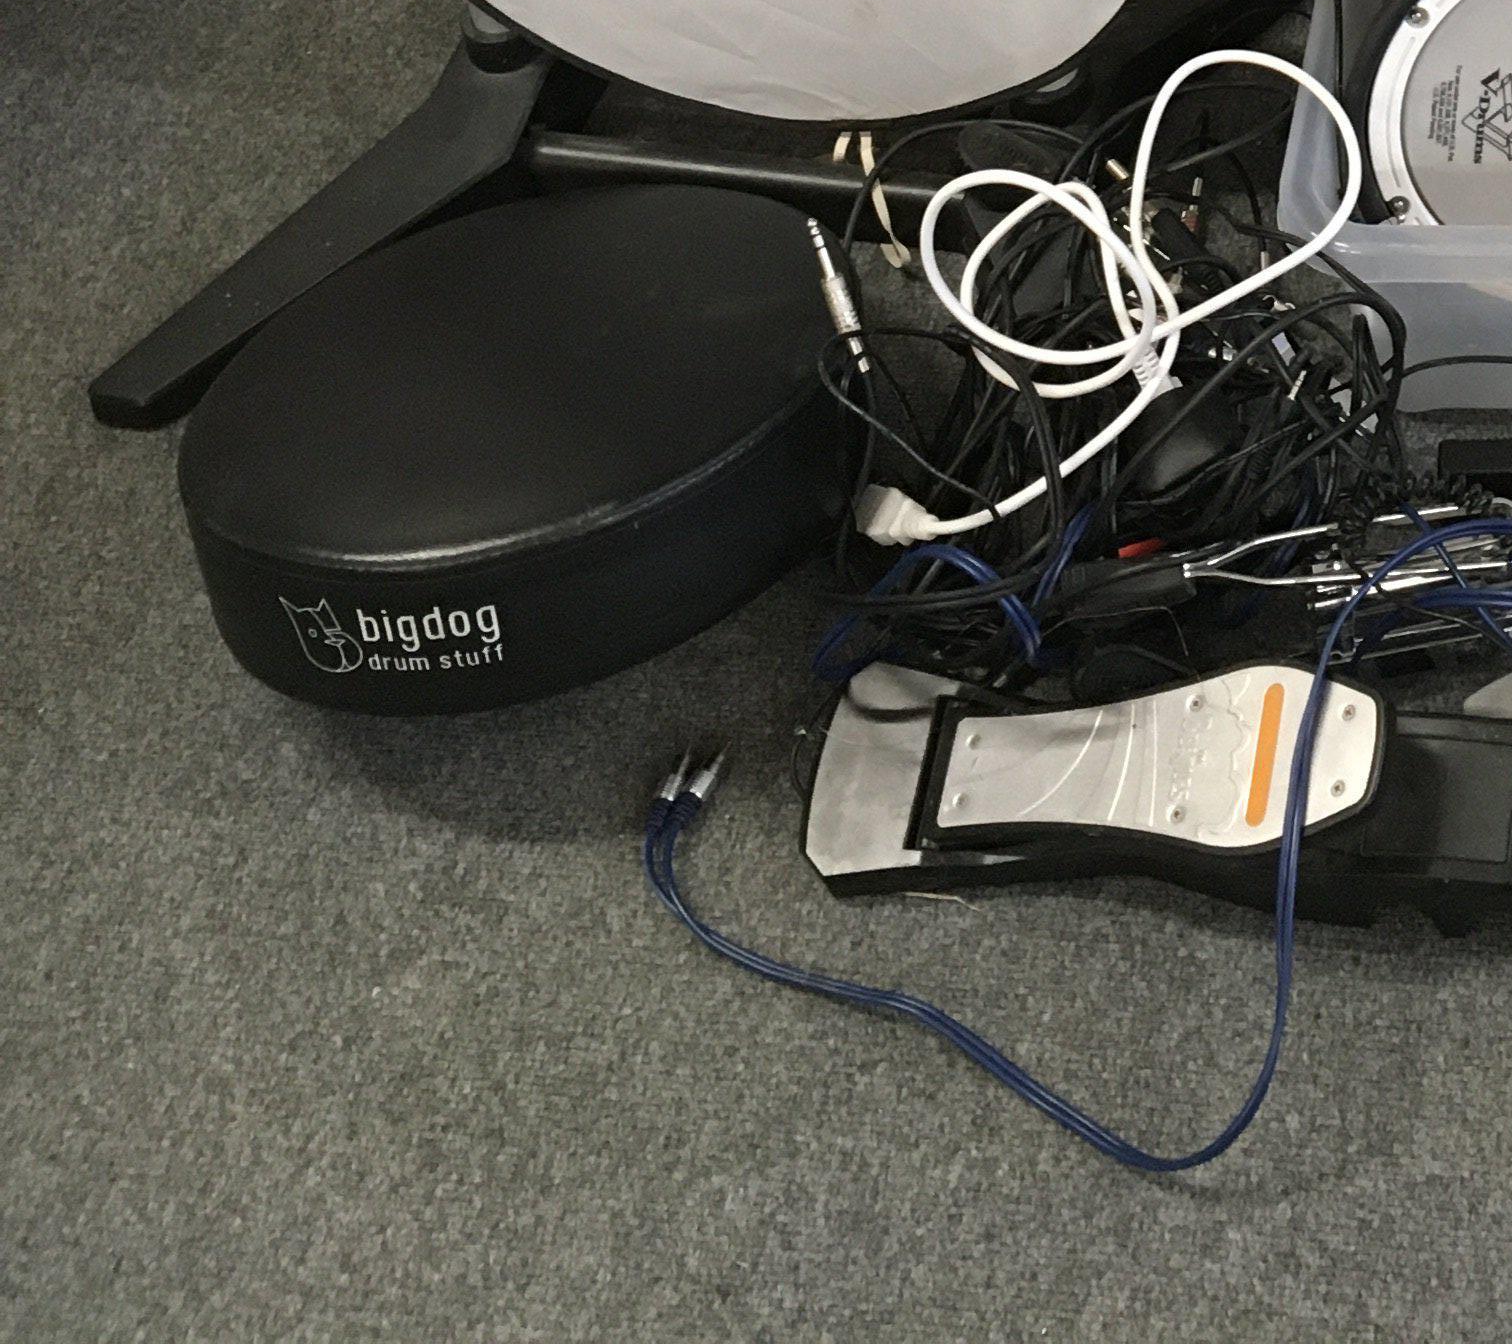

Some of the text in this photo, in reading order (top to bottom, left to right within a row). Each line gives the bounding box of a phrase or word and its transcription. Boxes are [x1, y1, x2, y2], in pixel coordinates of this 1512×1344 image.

[355, 604, 501, 653] bigdog
[367, 643, 504, 671] drum stuff
